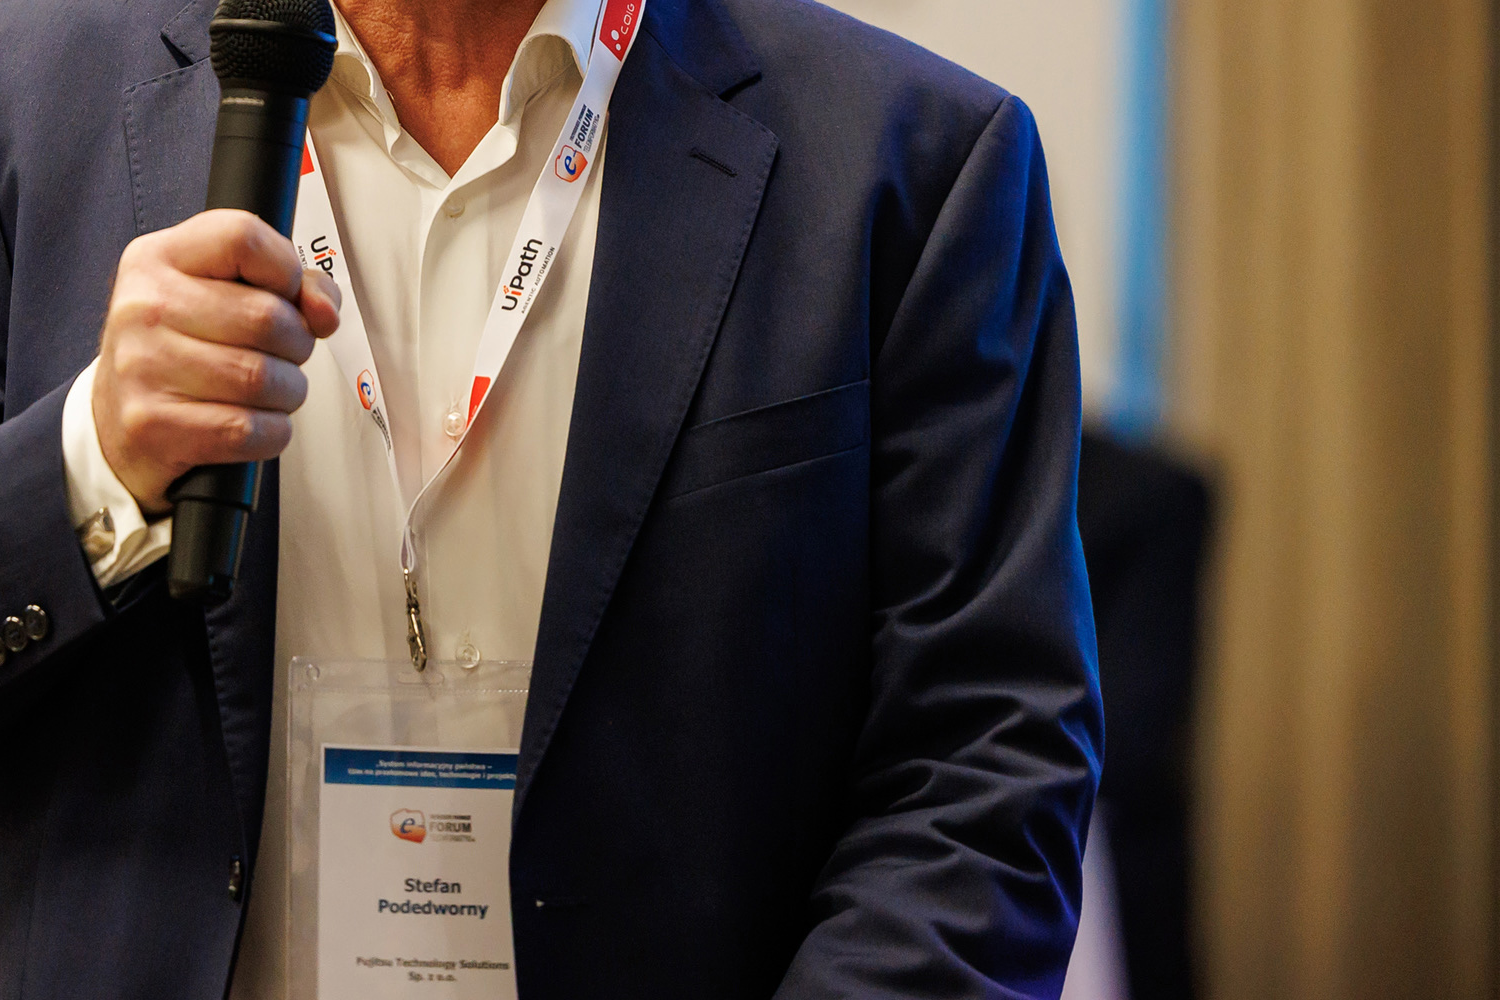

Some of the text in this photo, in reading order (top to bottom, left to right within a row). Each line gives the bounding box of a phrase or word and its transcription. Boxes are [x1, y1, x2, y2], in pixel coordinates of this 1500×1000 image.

[620, 3, 635, 35] COIG
[575, 108, 594, 149] FORUM
[501, 238, 543, 311] UiPath
[534, 246, 556, 286] AUTOMATION
[429, 821, 471, 832] FORUM
[404, 878, 461, 893] Stefan
[378, 899, 489, 919] Podedworny
[356, 957, 510, 970] Fujitsu Technology Solutions
